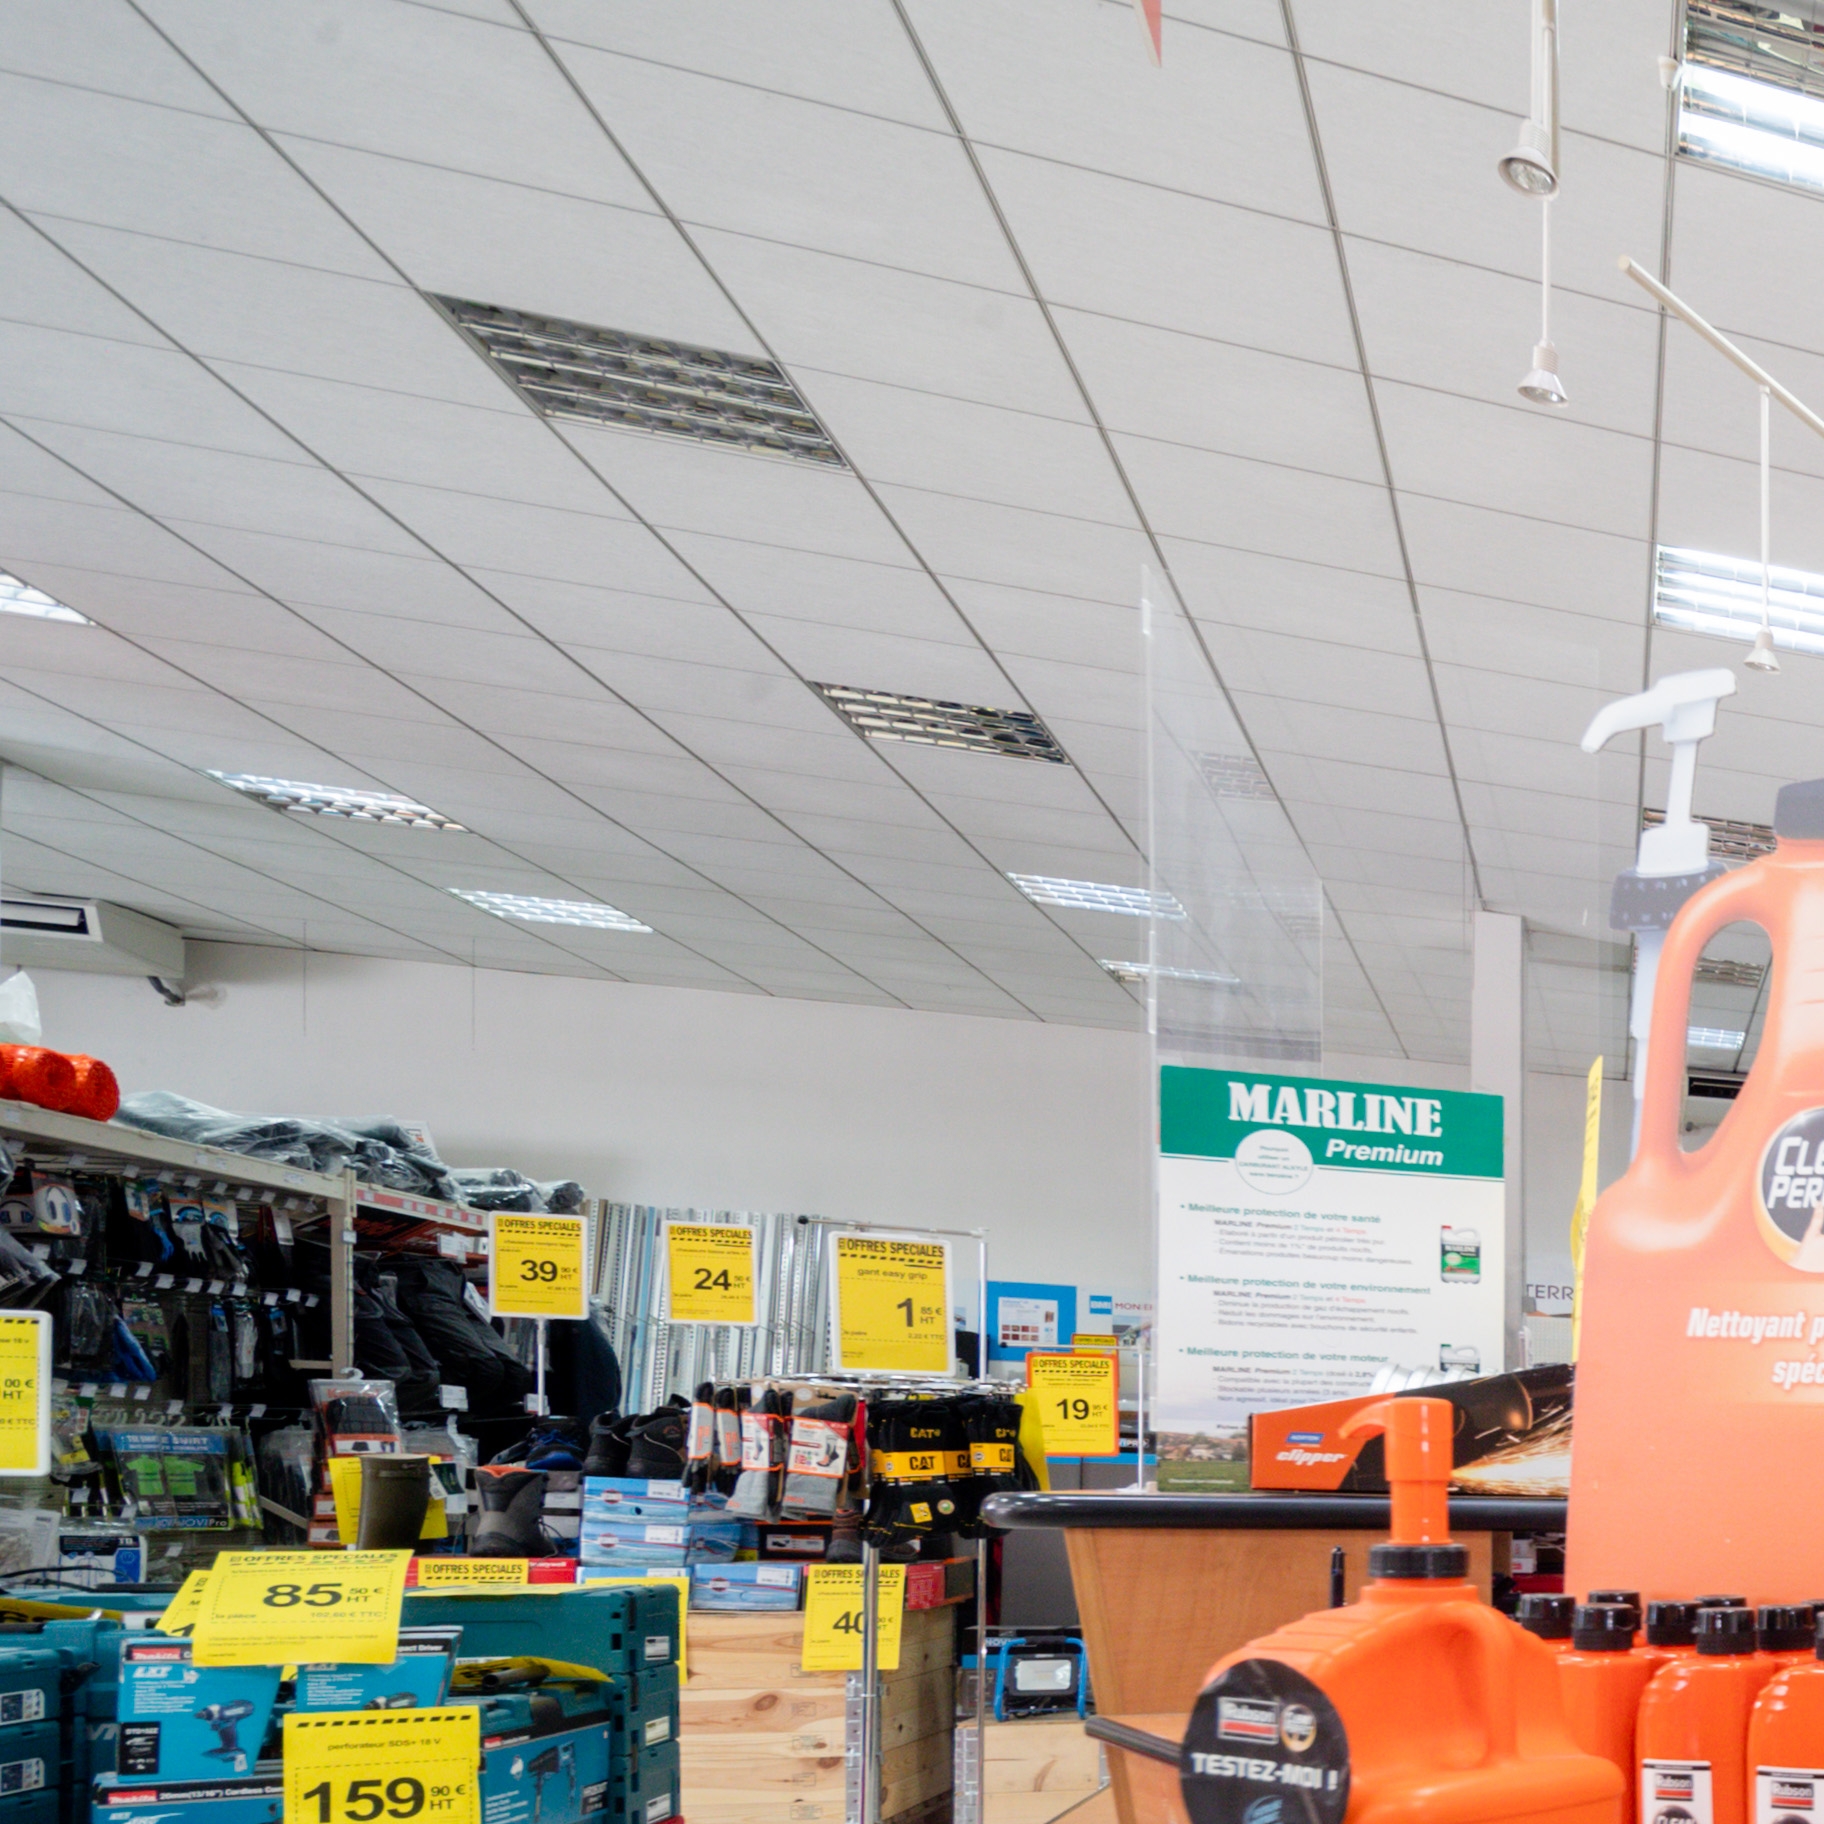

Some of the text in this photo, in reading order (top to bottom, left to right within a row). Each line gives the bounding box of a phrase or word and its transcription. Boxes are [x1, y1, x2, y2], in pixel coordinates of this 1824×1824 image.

[1227, 1081, 1443, 1138] MARLINE
[1325, 1138, 1444, 1167] Premium
[1188, 1203, 1381, 1223] Meilleure protection de votre santé
[847, 1239, 944, 1258] OFFRES SPECIALES
[520, 1259, 558, 1282] 39
[693, 1268, 732, 1290] 24
[857, 1268, 928, 1282] gant easy grip
[1188, 1274, 1431, 1294] Meilleure protection de votre environnement
[1526, 1284, 1573, 1300] TERR
[897, 1297, 914, 1327] 1
[1687, 1307, 1805, 1344] Nettoyant
[1187, 1347, 1389, 1363] Meilleure protection de votre moteur
[1056, 1398, 1089, 1420] 19
[910, 1455, 935, 1470] CAT
[1276, 1449, 1347, 1464] clipper
[433, 1563, 522, 1574] OFFRES SPECIALES
[262, 1583, 342, 1607] 85
[328, 1742, 385, 1751] perforateur
[1192, 1752, 1322, 1790] TESTEZ-MOI
[303, 1777, 425, 1824] 159
[430, 1786, 451, 1796] 90
[1772, 1783, 1813, 1798] Rubson
[430, 1799, 455, 1810] HT
